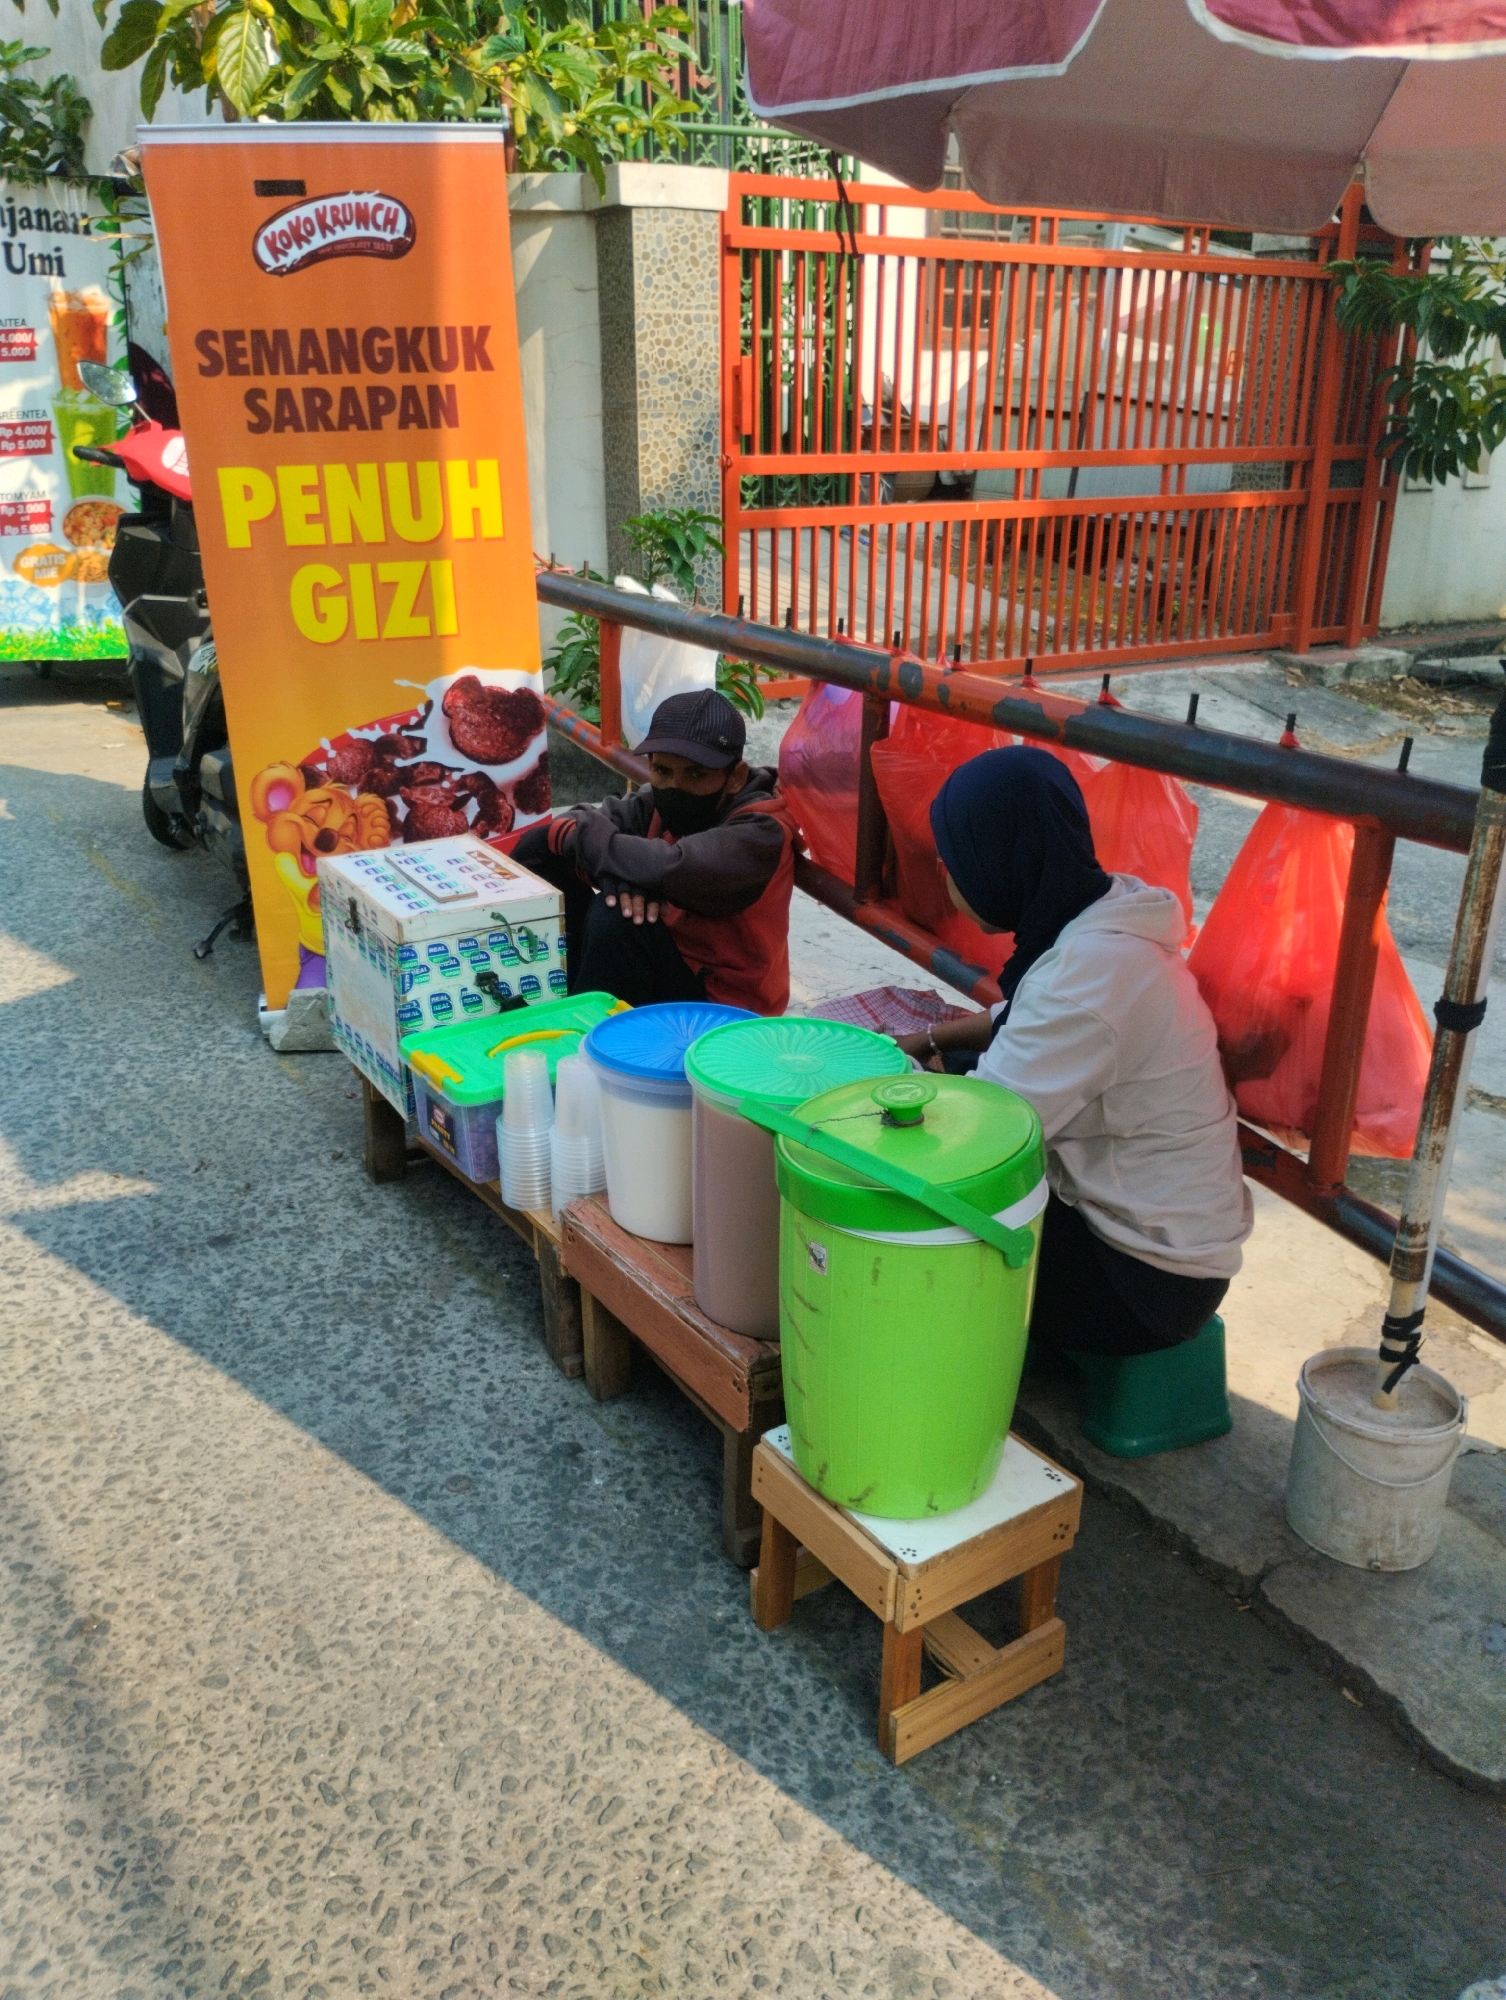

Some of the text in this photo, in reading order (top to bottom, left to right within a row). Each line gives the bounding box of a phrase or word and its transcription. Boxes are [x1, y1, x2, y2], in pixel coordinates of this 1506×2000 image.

[2, 241, 66, 277] Umi
[1, 347, 30, 357] 5.000
[193, 324, 495, 378] SEMANGKUK
[243, 383, 460, 435] SARAPAN
[1, 438, 46, 452] Rp 5.000
[0, 502, 46, 517] Rp 3.000
[216, 458, 505, 549] PENUH
[4, 522, 50, 536] Rp 5.000
[19, 553, 67, 569] GRATIS
[34, 566, 59, 580] MIE
[289, 558, 460, 644] GIZI
[460, 940, 477, 949] REAL
[490, 935, 506, 943] REAL
[428, 945, 447, 954] REAL
[433, 1002, 451, 1012] REAL
[464, 996, 480, 1004] REAL
